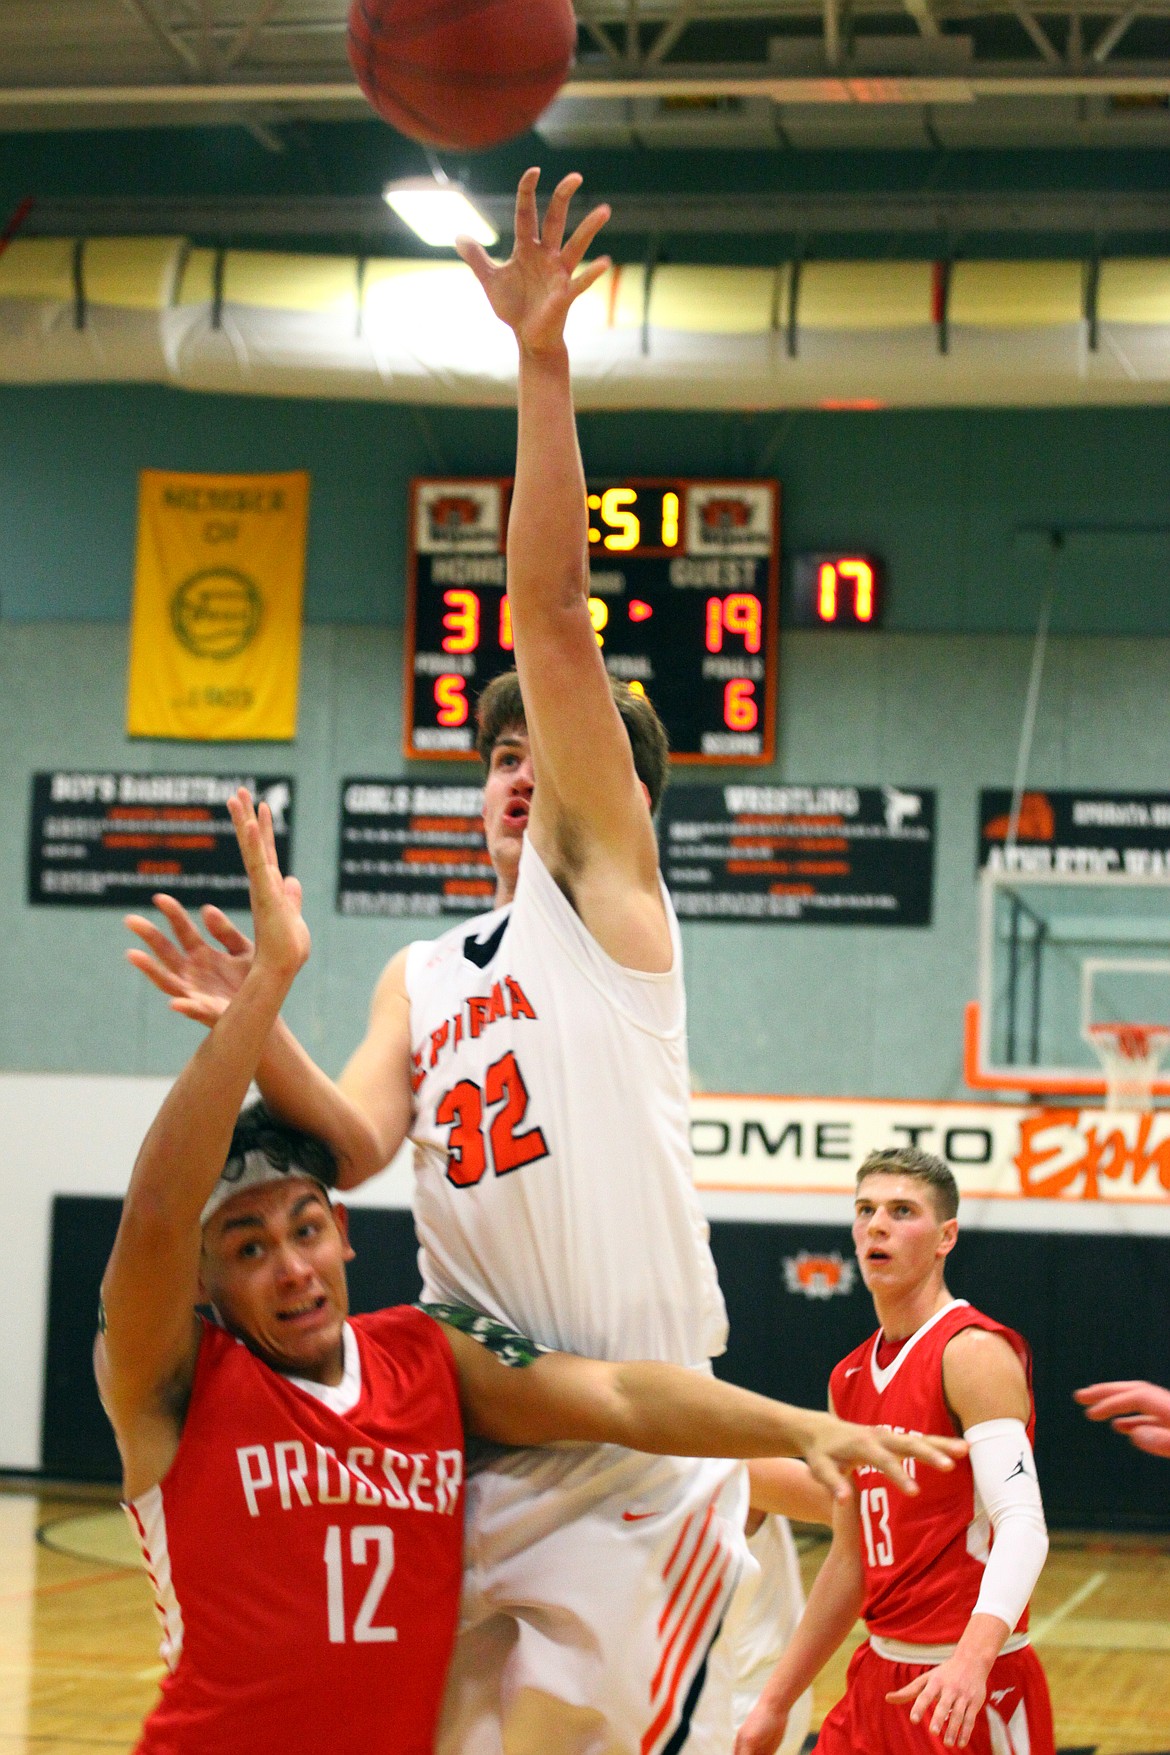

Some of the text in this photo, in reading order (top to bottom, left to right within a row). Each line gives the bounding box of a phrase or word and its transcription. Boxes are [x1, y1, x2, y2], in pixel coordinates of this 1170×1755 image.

[818, 558, 873, 622] 17
[705, 593, 762, 654] 19
[434, 673, 469, 727] 5
[723, 677, 758, 732] 6
[724, 785, 860, 817] WRESTLING
[435, 1050, 551, 1188] 32
[894, 1125, 994, 1164] TO
[236, 1440, 463, 1518] PROSSER
[860, 1487, 895, 1568] 13
[323, 1525, 398, 1645] 12
